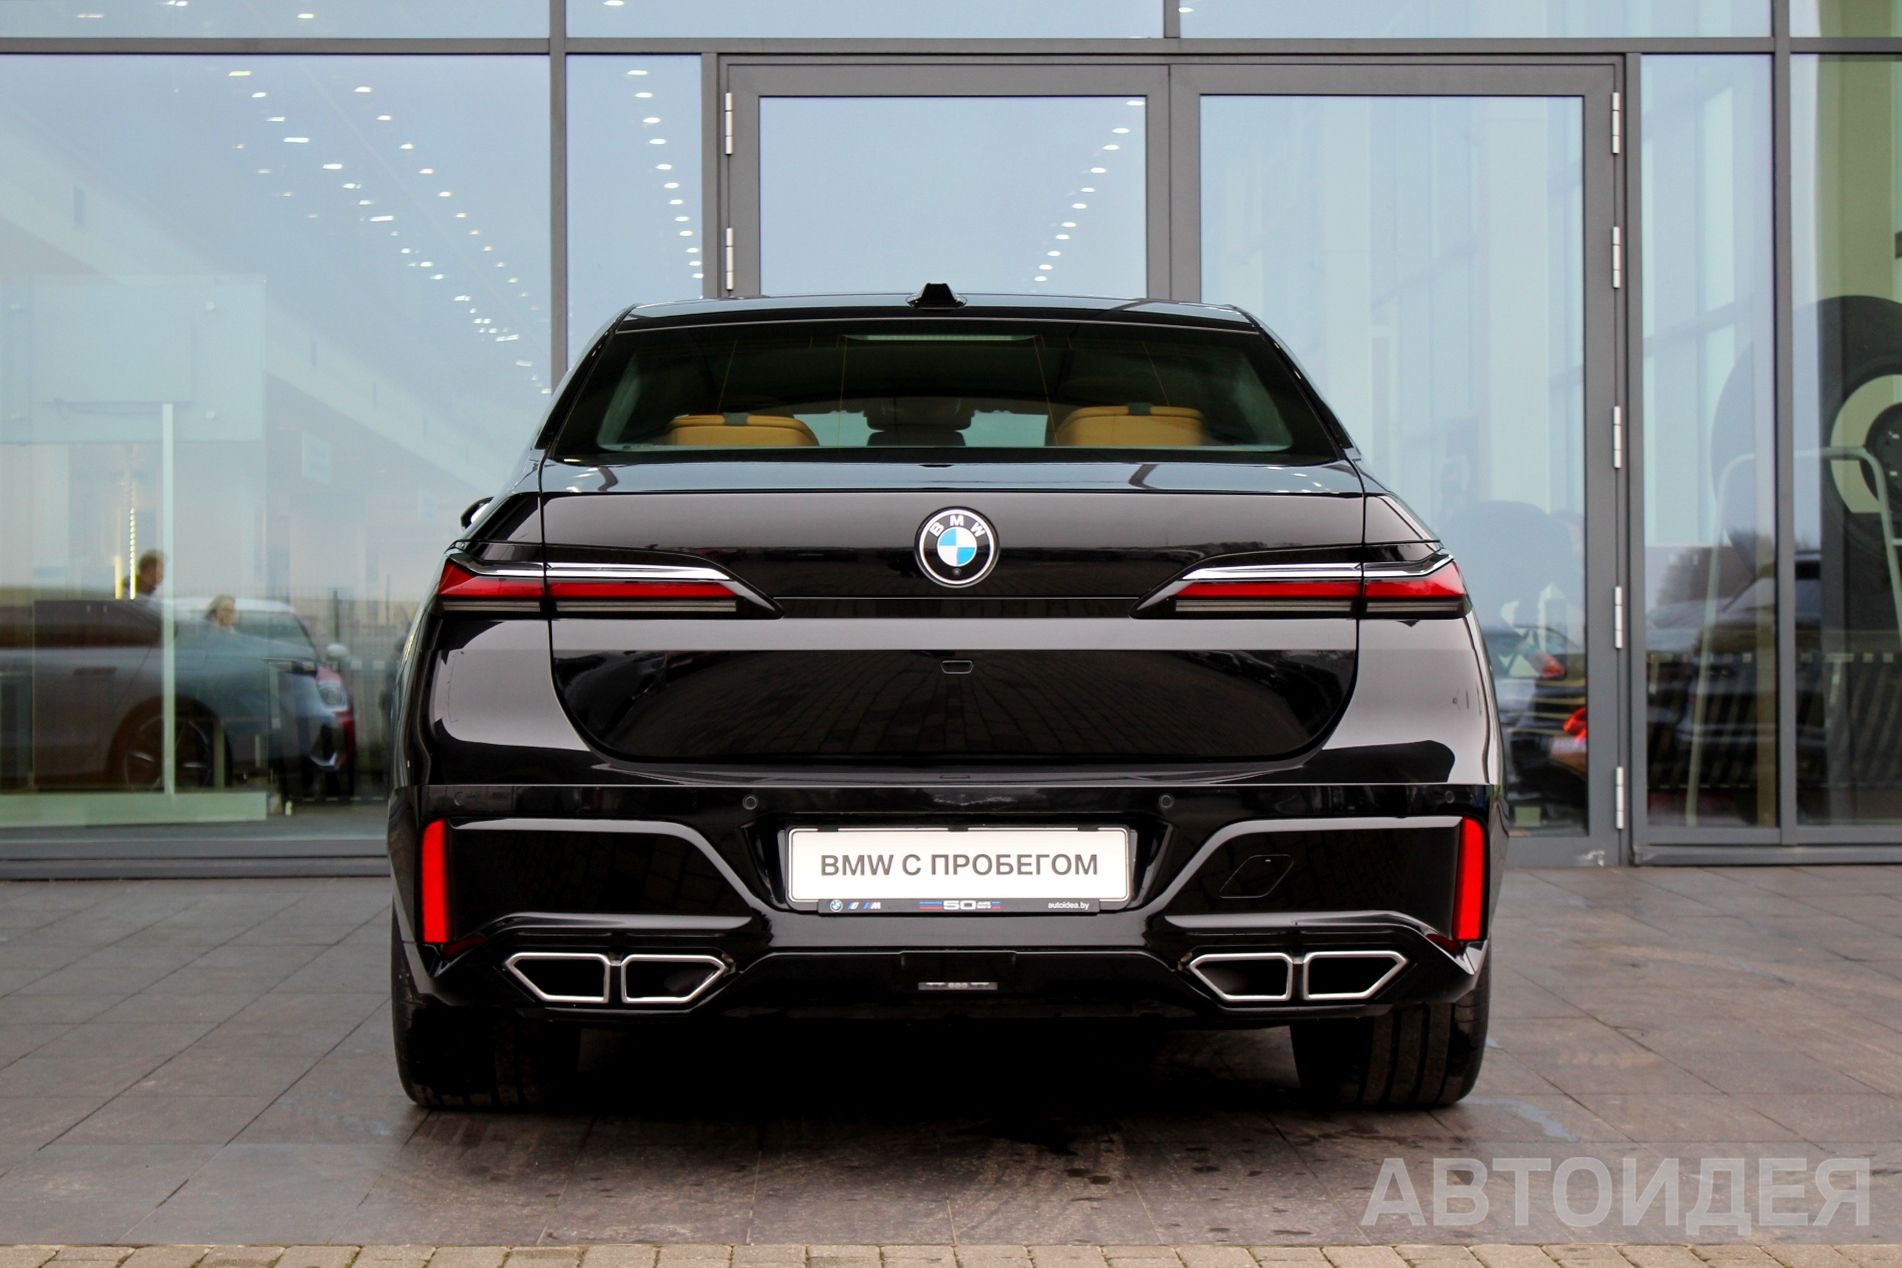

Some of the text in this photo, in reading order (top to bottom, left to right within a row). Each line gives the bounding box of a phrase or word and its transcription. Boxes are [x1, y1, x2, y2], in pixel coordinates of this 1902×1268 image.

[929, 515, 986, 537] BMW
[821, 853, 1098, 876] BMW С ПРОБЕГОМ
[943, 900, 977, 910] 50
[1047, 901, 1090, 911] autoidea.by
